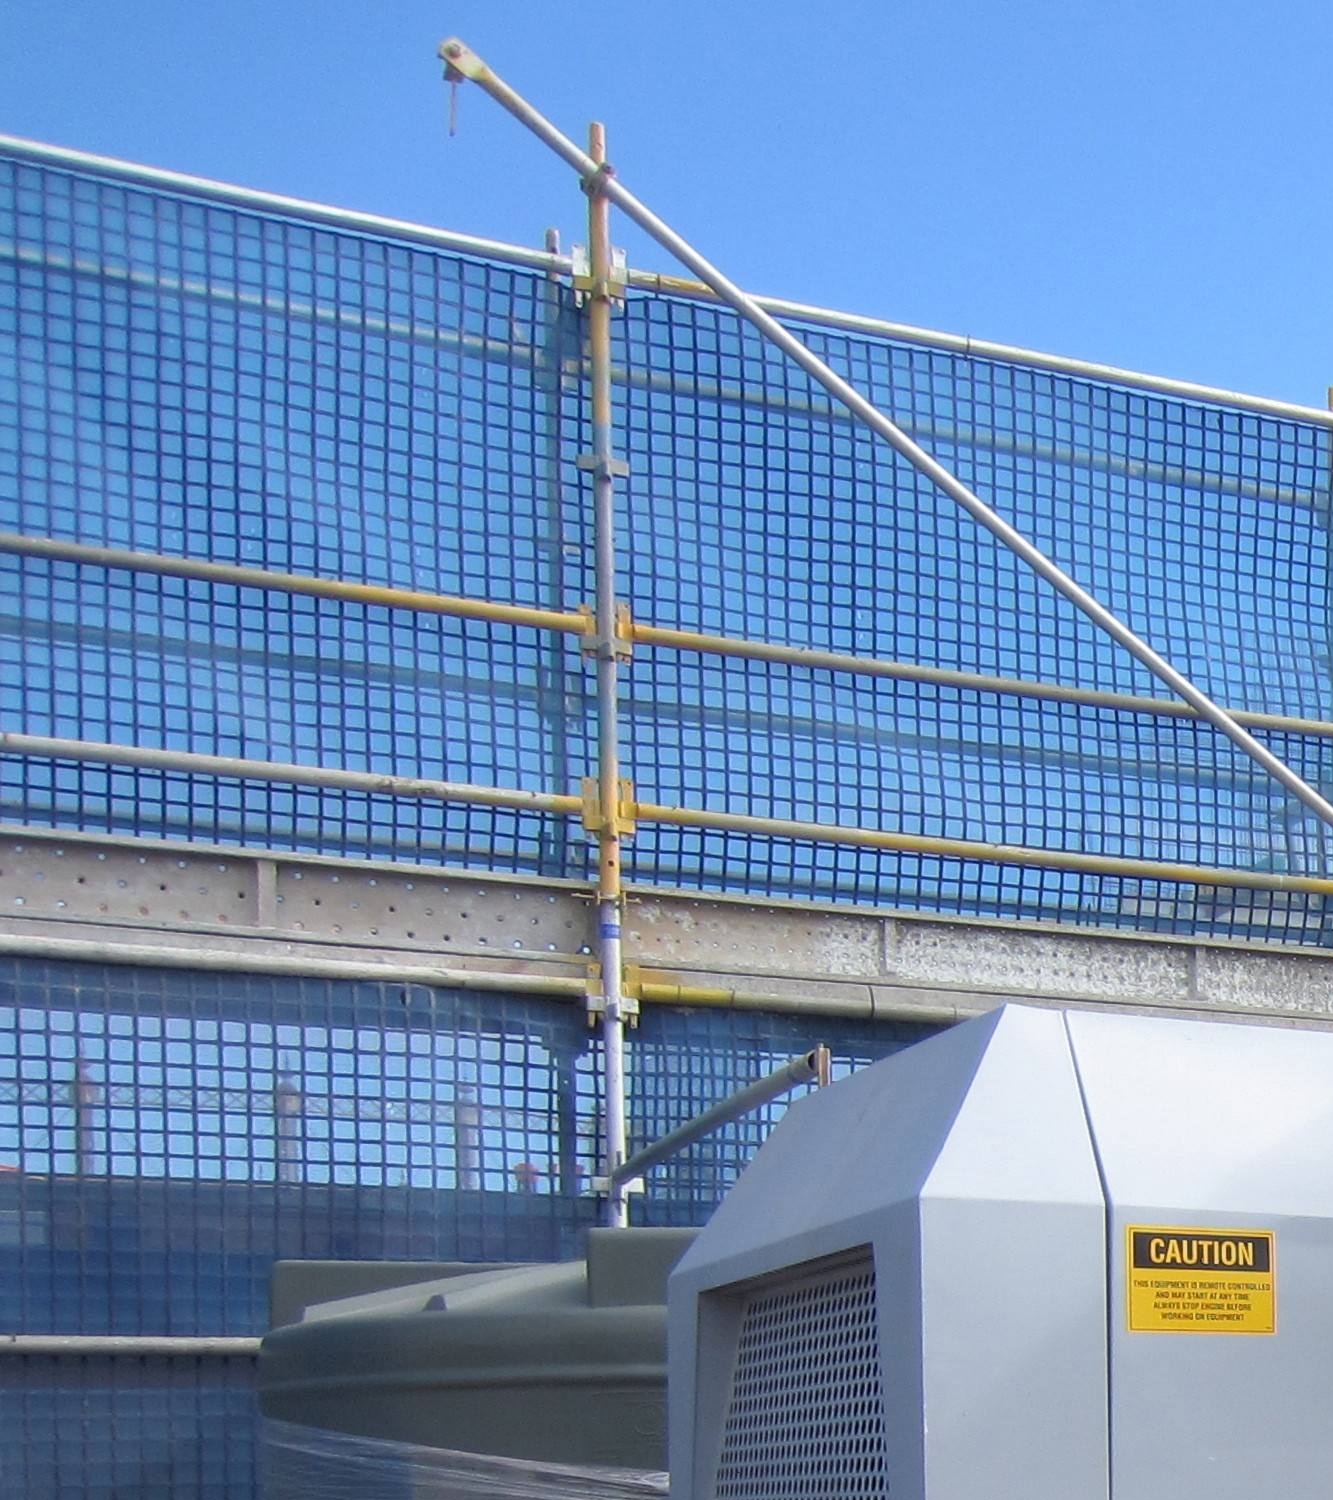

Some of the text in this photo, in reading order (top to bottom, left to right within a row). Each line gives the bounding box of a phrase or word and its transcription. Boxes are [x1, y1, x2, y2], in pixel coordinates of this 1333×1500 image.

[1150, 1238, 1254, 1266] CAUTION
[1134, 1280, 1271, 1291] THIS EQUIPMENT IS REMOTE CONTROLLED
[1155, 1291, 1169, 1299] AND
[1171, 1291, 1185, 1299] MAY
[1187, 1292, 1208, 1300] START
[1234, 1293, 1250, 1301] TIME
[1153, 1302, 1252, 1311] ALWAYS STOP ENGINE BEFORE
[1161, 1312, 1194, 1320] WORKING
[1207, 1313, 1244, 1321] EQUIPMENT
